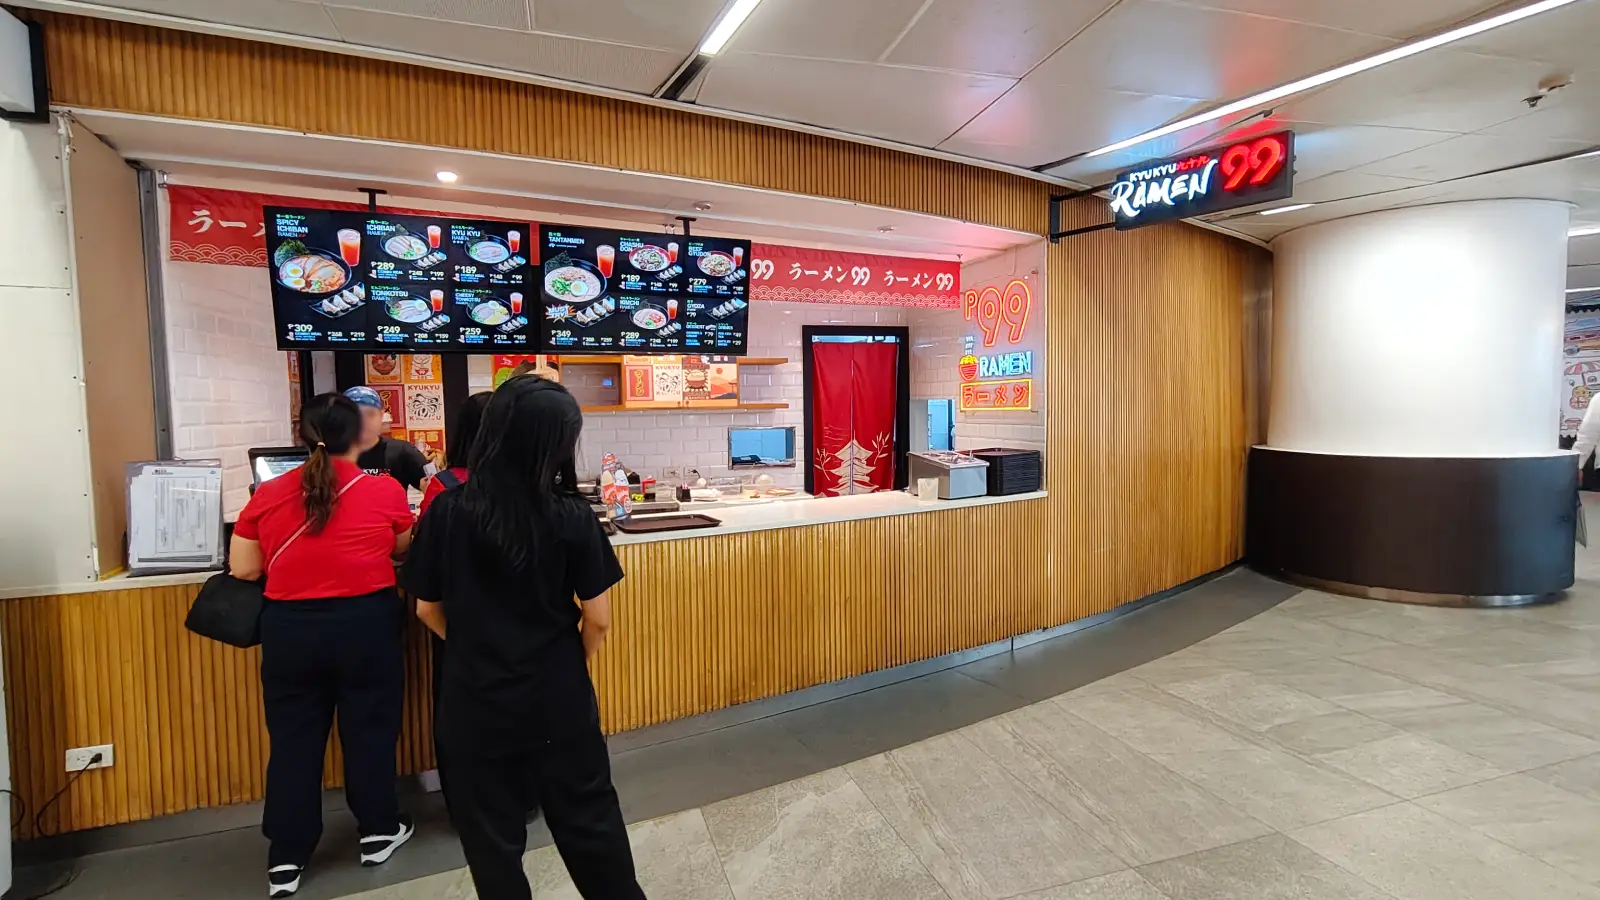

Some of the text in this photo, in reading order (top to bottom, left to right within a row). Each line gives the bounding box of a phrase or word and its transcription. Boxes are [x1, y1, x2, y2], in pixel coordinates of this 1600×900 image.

[1130, 163, 1176, 182] KYUKYU
[1221, 137, 1285, 191] 99
[1110, 159, 1219, 218] RAMEN
[751, 258, 774, 280] 99
[980, 350, 1032, 378] RAMEN
[964, 384, 1028, 408] ラーメン
